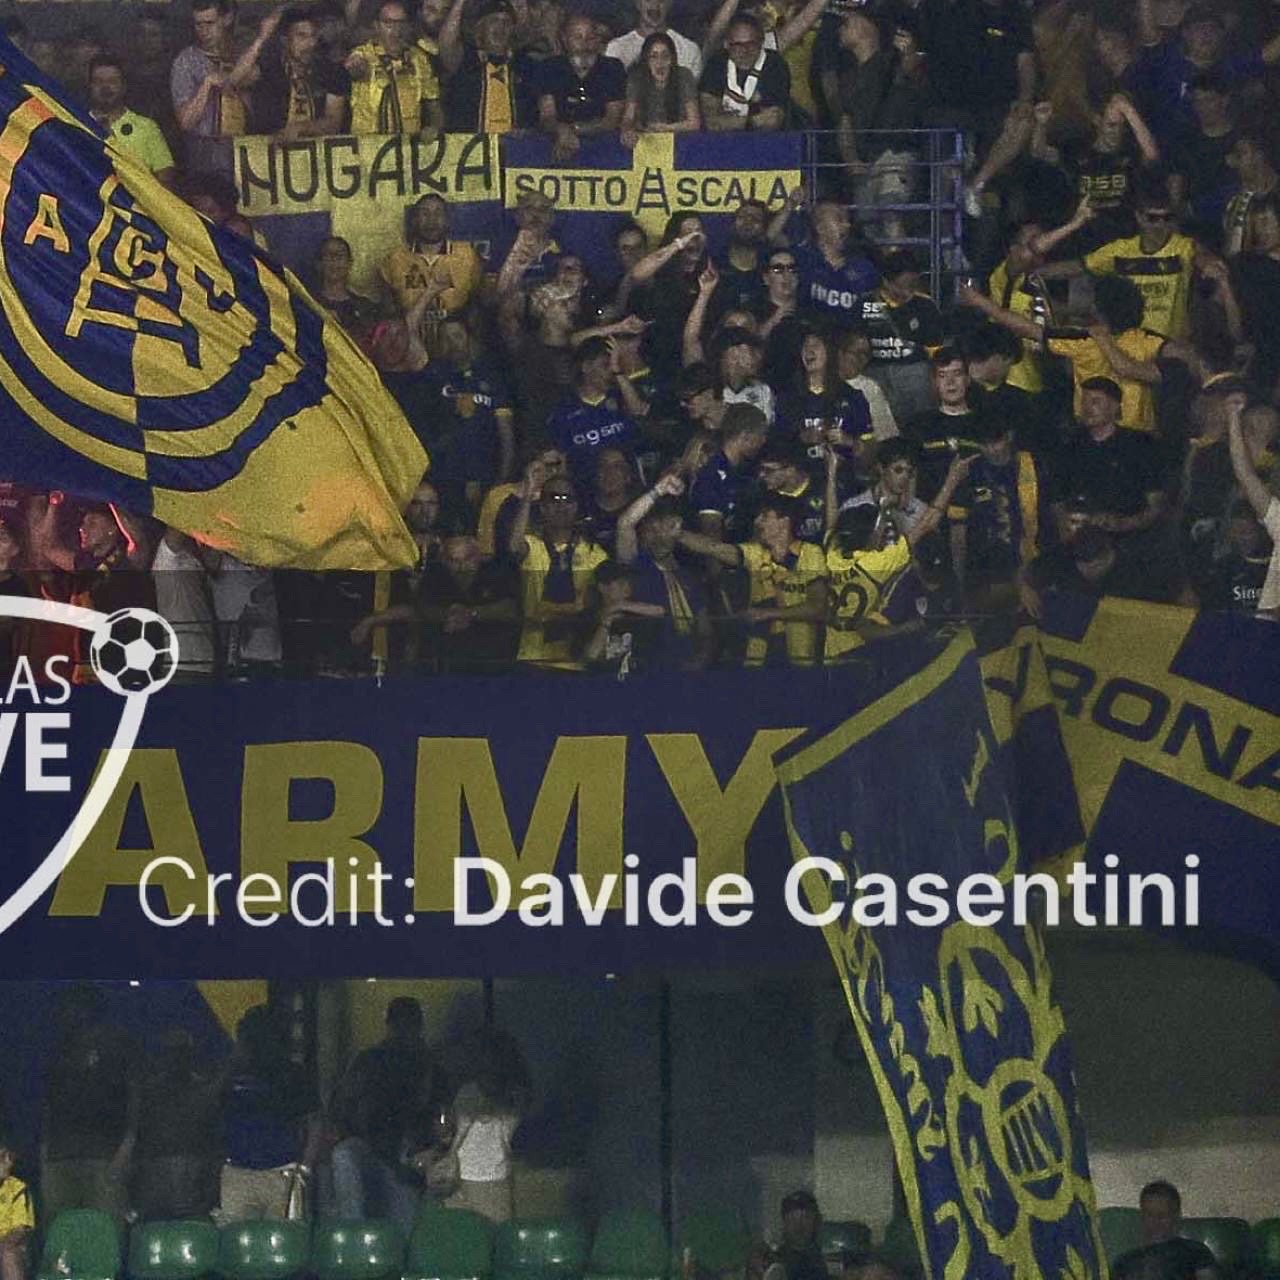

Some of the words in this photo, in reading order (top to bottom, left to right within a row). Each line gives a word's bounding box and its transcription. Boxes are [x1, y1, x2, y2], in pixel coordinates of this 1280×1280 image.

[239, 133, 495, 209] NOGARA
[514, 175, 627, 209] SOTTO
[677, 175, 790, 210] SCALA
[47, 727, 806, 917] ARMY
